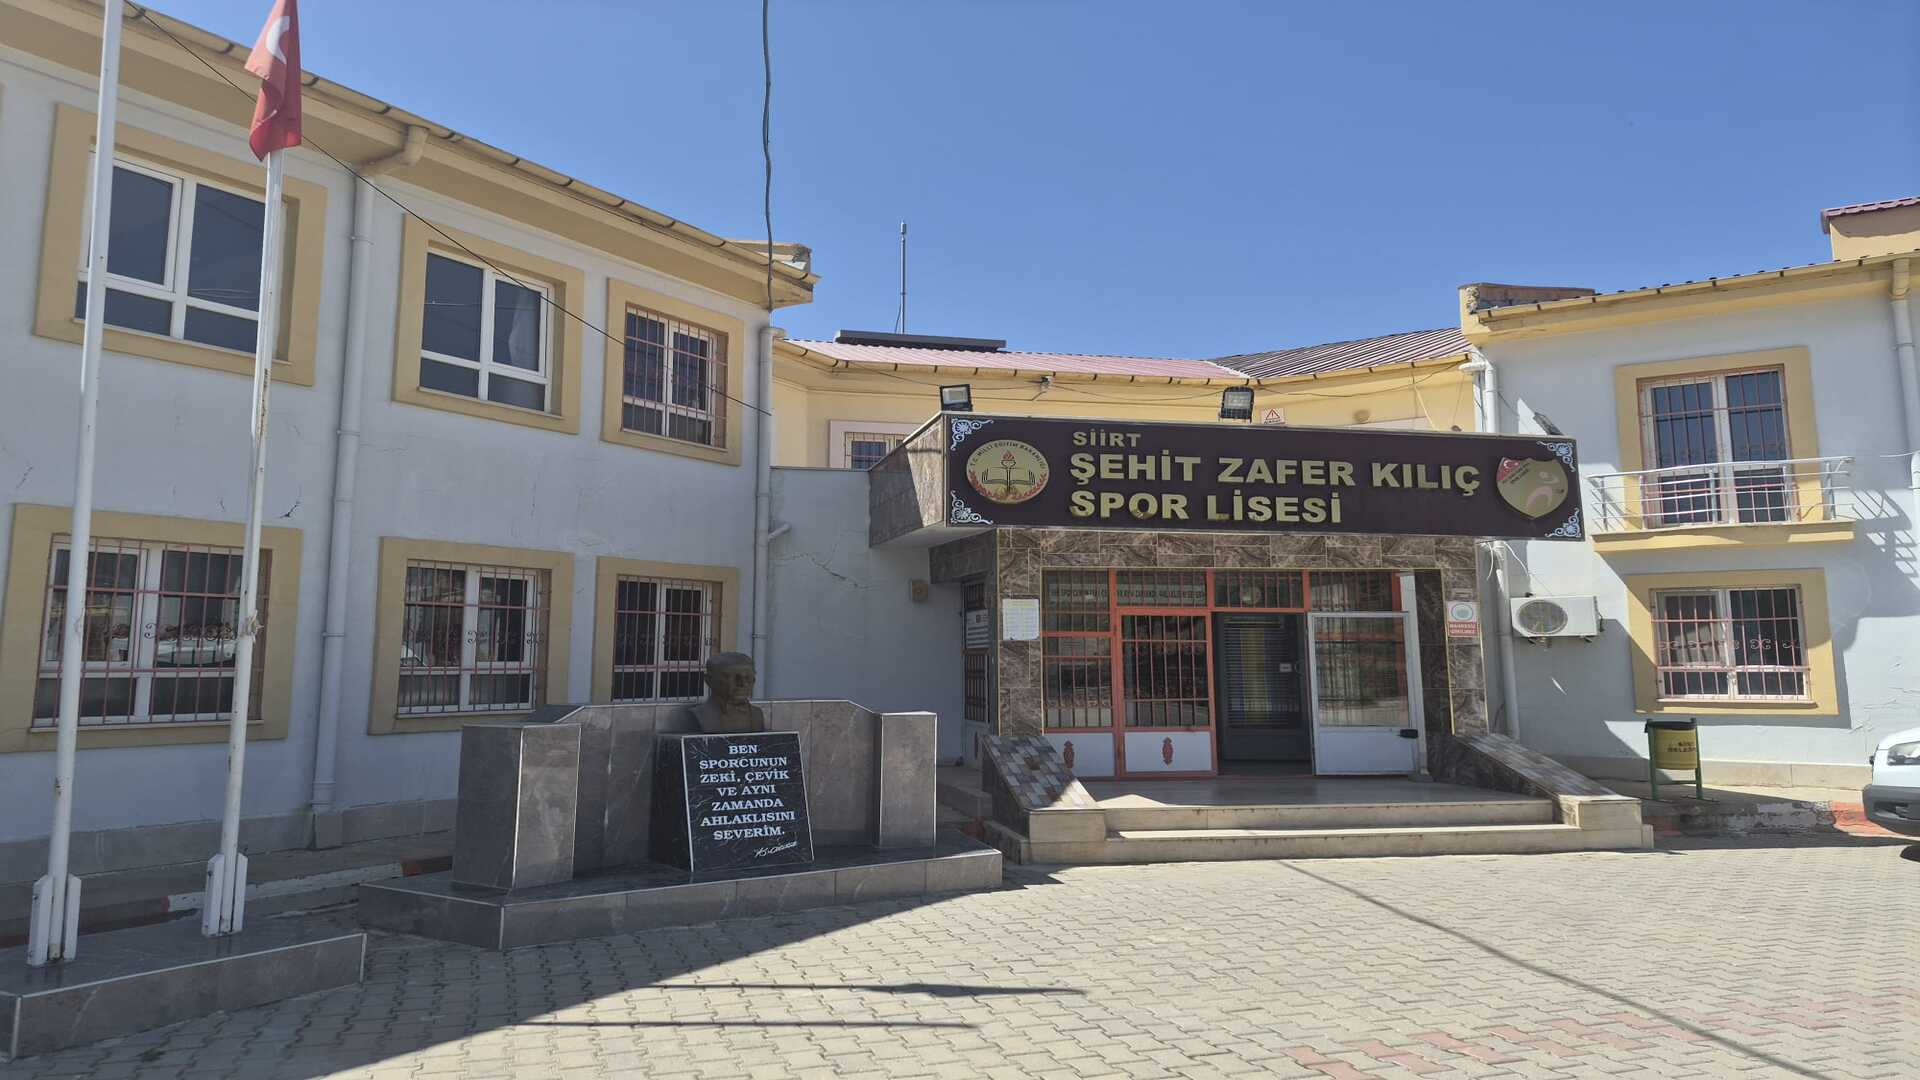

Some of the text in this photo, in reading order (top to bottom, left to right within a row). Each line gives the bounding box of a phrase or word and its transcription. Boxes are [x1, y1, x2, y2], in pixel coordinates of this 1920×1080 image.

[1073, 428, 1141, 447] SİİRT
[1070, 449, 1201, 485] ŞEHİT
[1217, 458, 1356, 487] ZAFER
[1371, 462, 1480, 496] KILIÇ
[1069, 489, 1341, 523] SPOR LİSESİ
[728, 744, 758, 755] BEN
[699, 757, 787, 769] SPORCUNUN
[745, 768, 790, 784] ÇEVİK
[717, 784, 776, 797] VE AYNI
[712, 798, 784, 811] ZAMANDA
[700, 811, 795, 827] AHLAKLISINI
[713, 825, 785, 840] SEVERİM.
